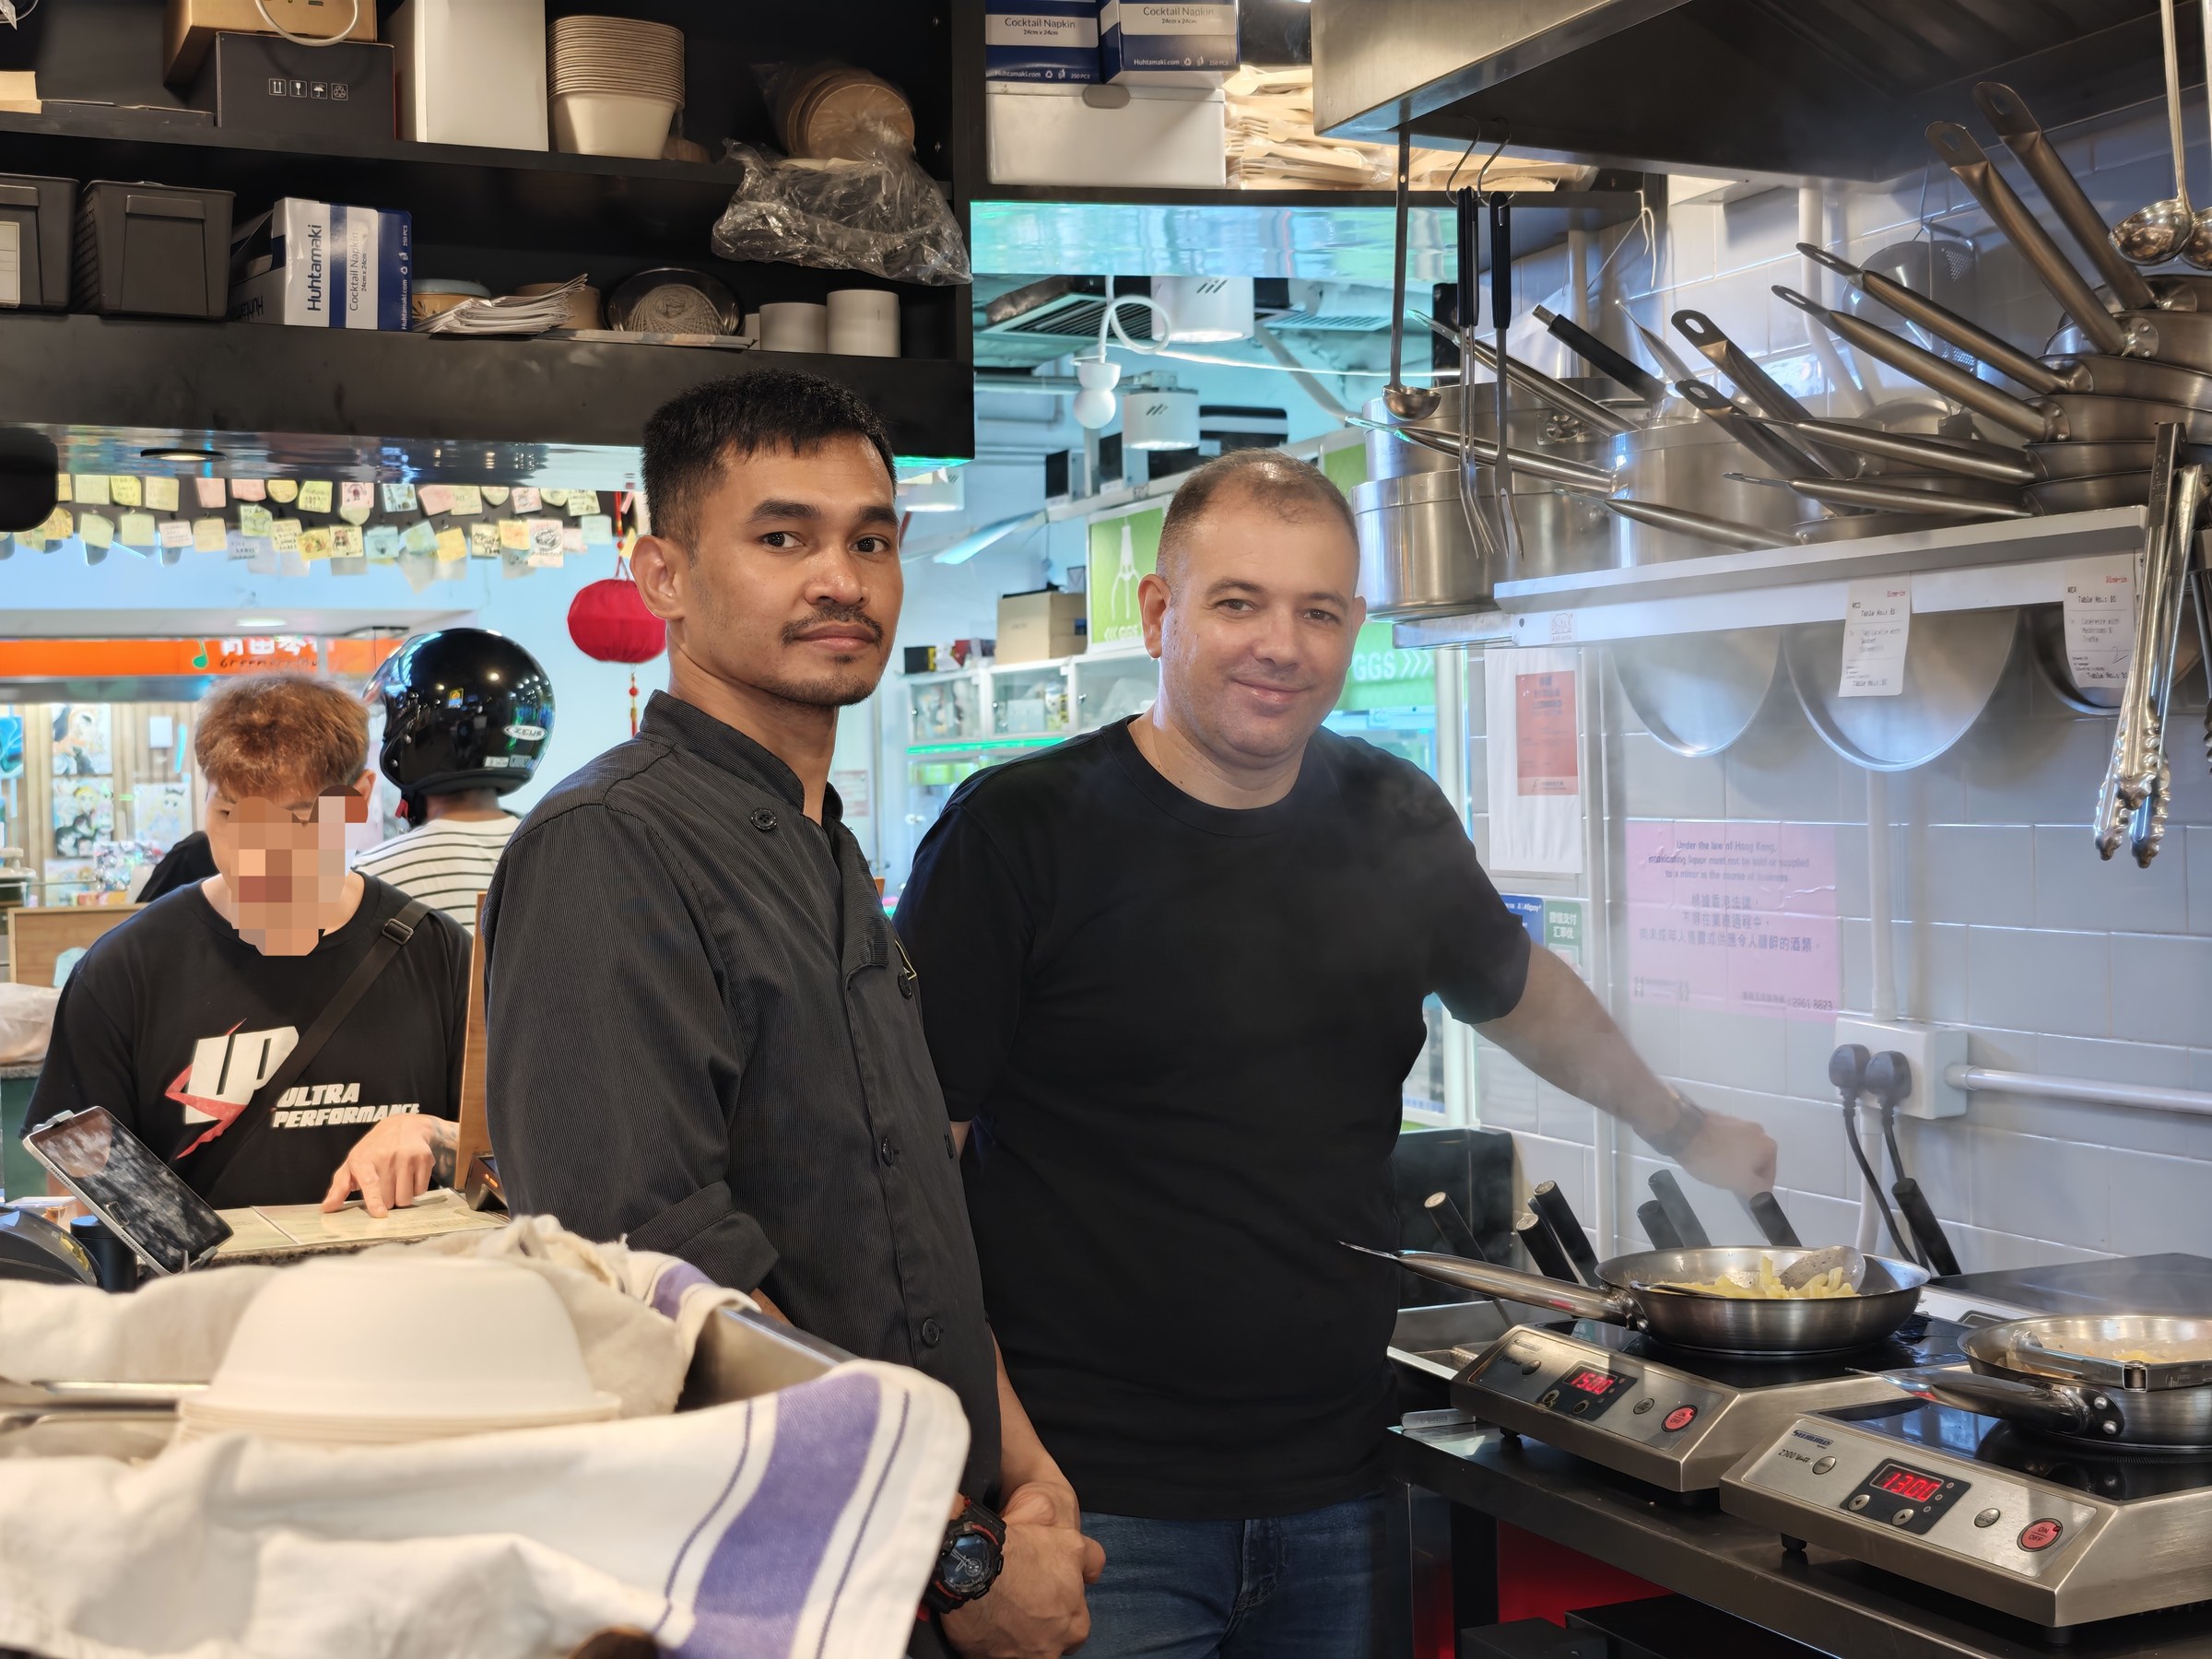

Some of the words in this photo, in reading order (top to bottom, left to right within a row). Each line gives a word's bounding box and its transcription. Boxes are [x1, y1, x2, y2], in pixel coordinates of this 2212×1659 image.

[1143, 6, 1181, 17] Cocktail
[1182, 7, 1214, 18] Napkin
[1005, 18, 1041, 28] Cocktail
[1043, 18, 1076, 29] Napkin
[995, 70, 1041, 78] Huhtamaki.com
[350, 231, 359, 265] Napkin
[307, 224, 323, 312] Huhtamaki
[349, 266, 359, 312] Cocktail
[1677, 841, 1696, 850] Under
[1699, 841, 1709, 850] the
[1711, 841, 1724, 850] law
[1725, 841, 1733, 851] of
[1735, 841, 1753, 853] Hong
[1679, 870, 1700, 879] minor
[1709, 870, 1721, 879] the
[276, 1082, 361, 1108] ULTRA
[1882, 1472, 1939, 1502] 1300
[2028, 1534, 2044, 1542] OFF
